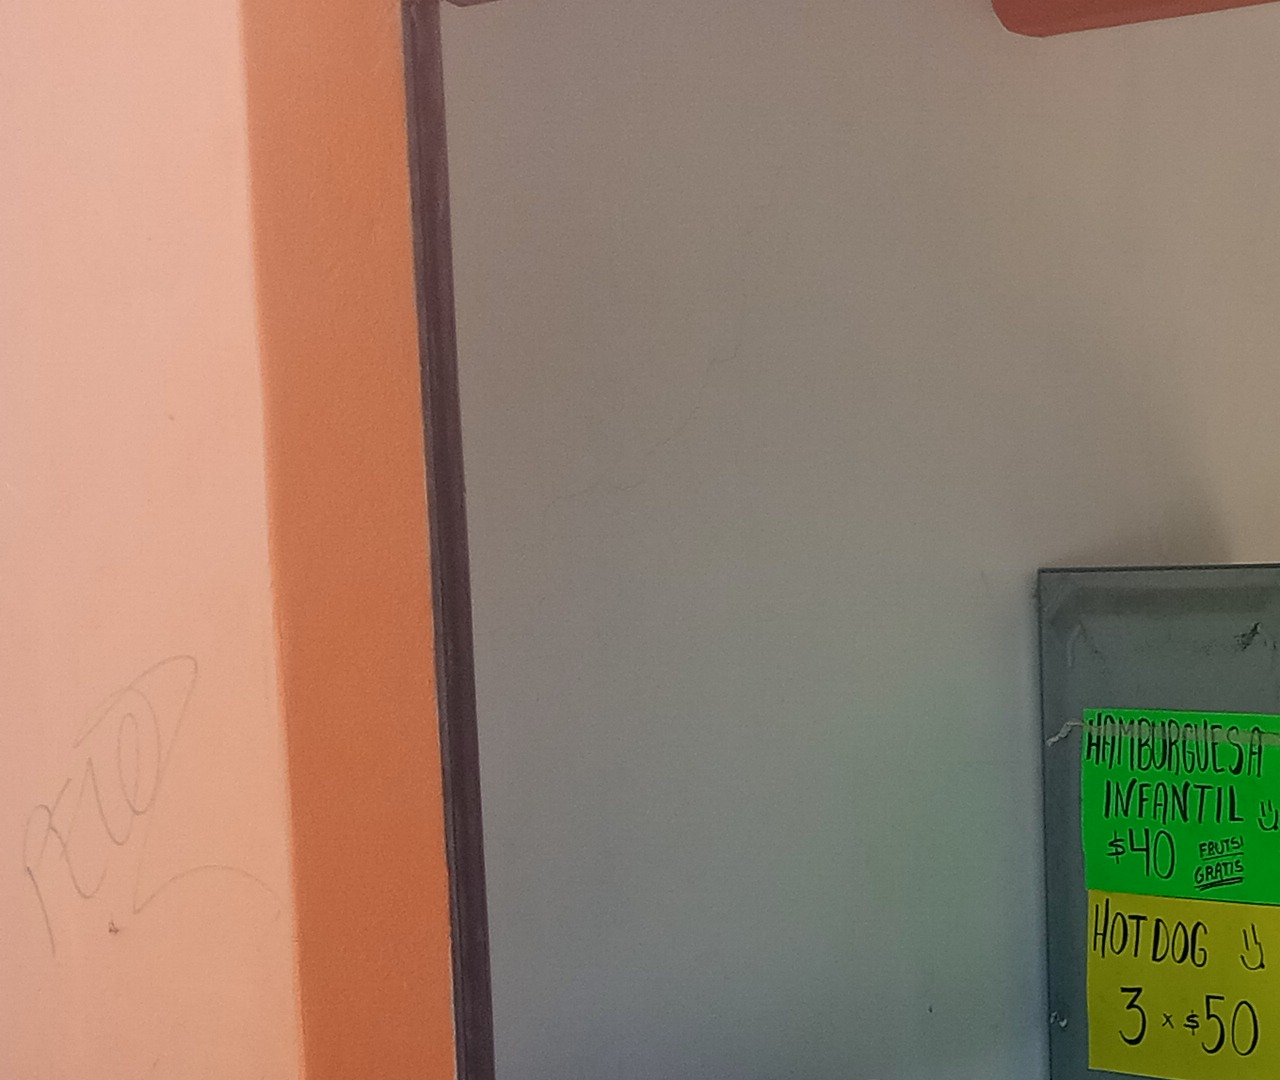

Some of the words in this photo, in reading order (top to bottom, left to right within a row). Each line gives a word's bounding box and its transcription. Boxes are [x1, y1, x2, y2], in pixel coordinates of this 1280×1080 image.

[1086, 713, 1263, 777] HAMBURGUESA
[1104, 778, 1244, 825] INFANTIL
[1106, 828, 1175, 880] $40
[1195, 859, 1244, 884] GRATIS
[1199, 835, 1244, 858] FRUTSI
[1093, 898, 1148, 959] HOT
[1151, 917, 1208, 968] DOG
[1119, 987, 1147, 1046] 3
[1183, 994, 1259, 1056] $50
